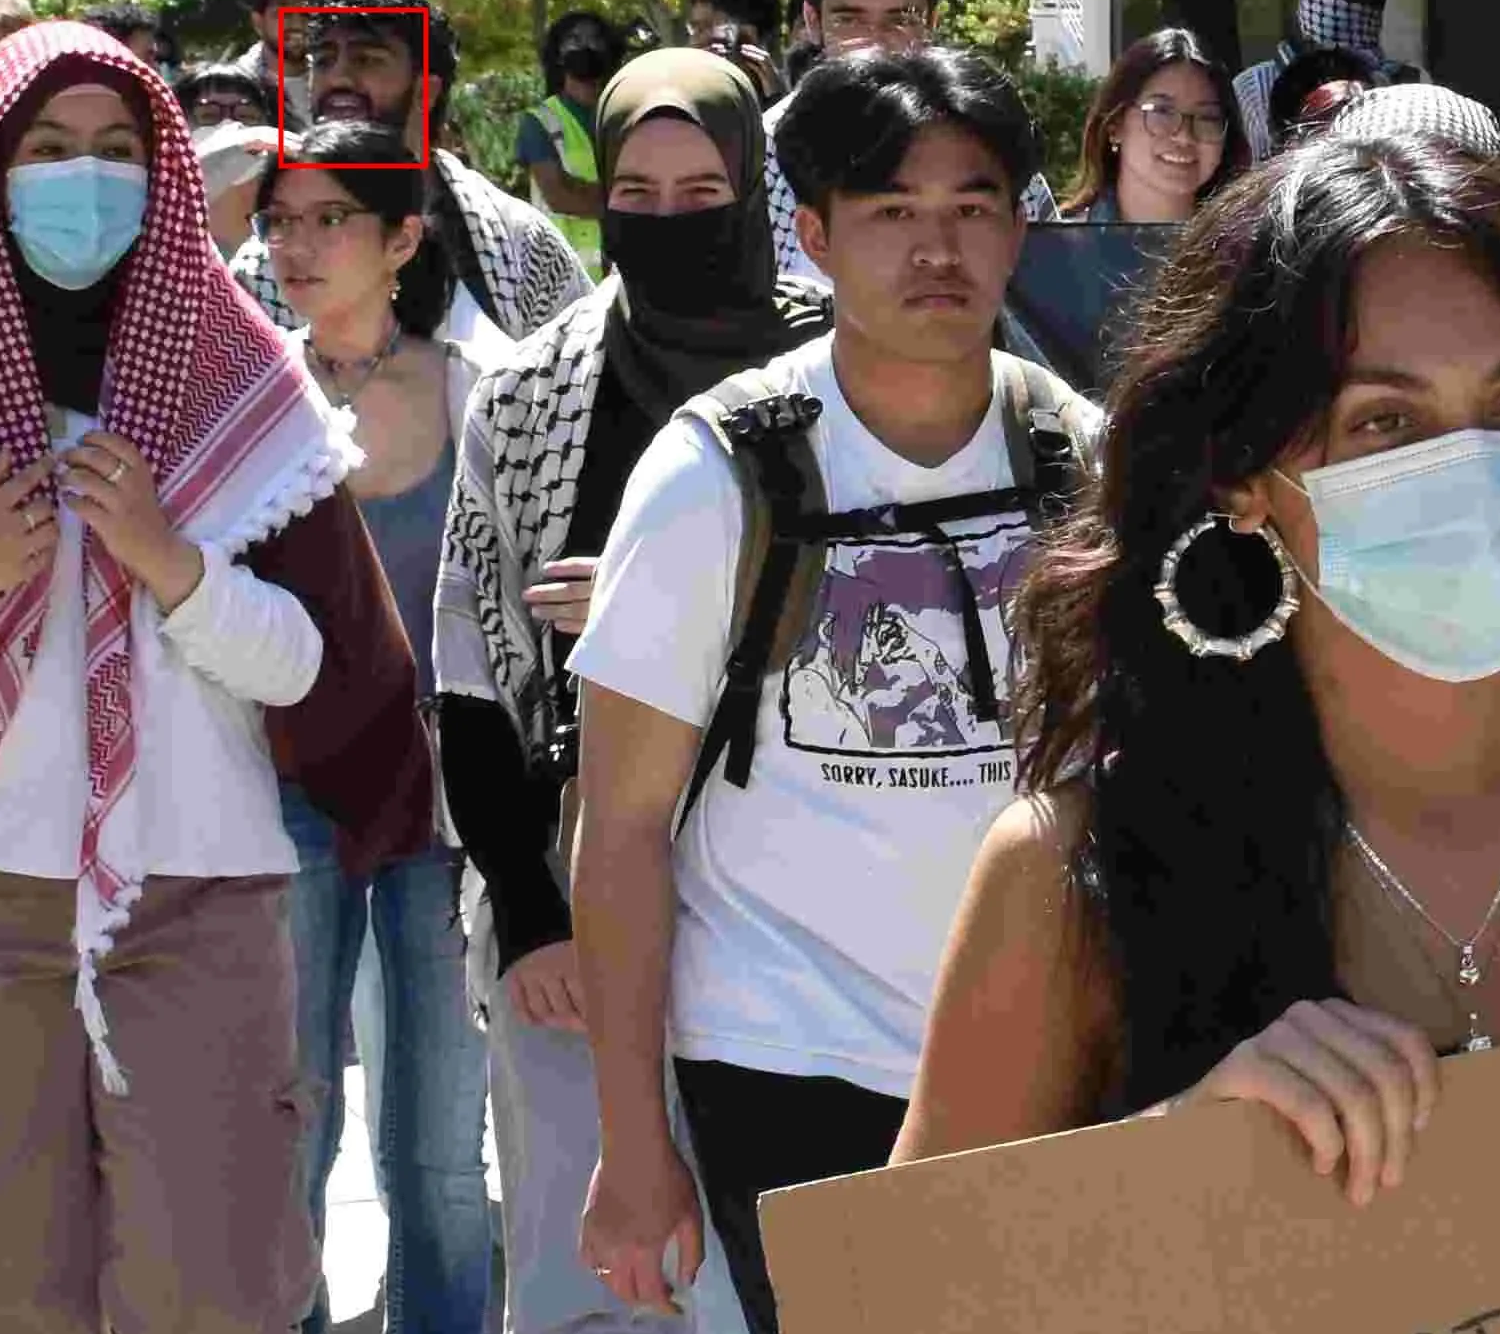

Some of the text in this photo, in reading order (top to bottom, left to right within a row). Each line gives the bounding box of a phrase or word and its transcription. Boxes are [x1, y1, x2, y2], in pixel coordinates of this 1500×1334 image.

[820, 761, 1012, 788] SORRY, SASUKE.... THIS
